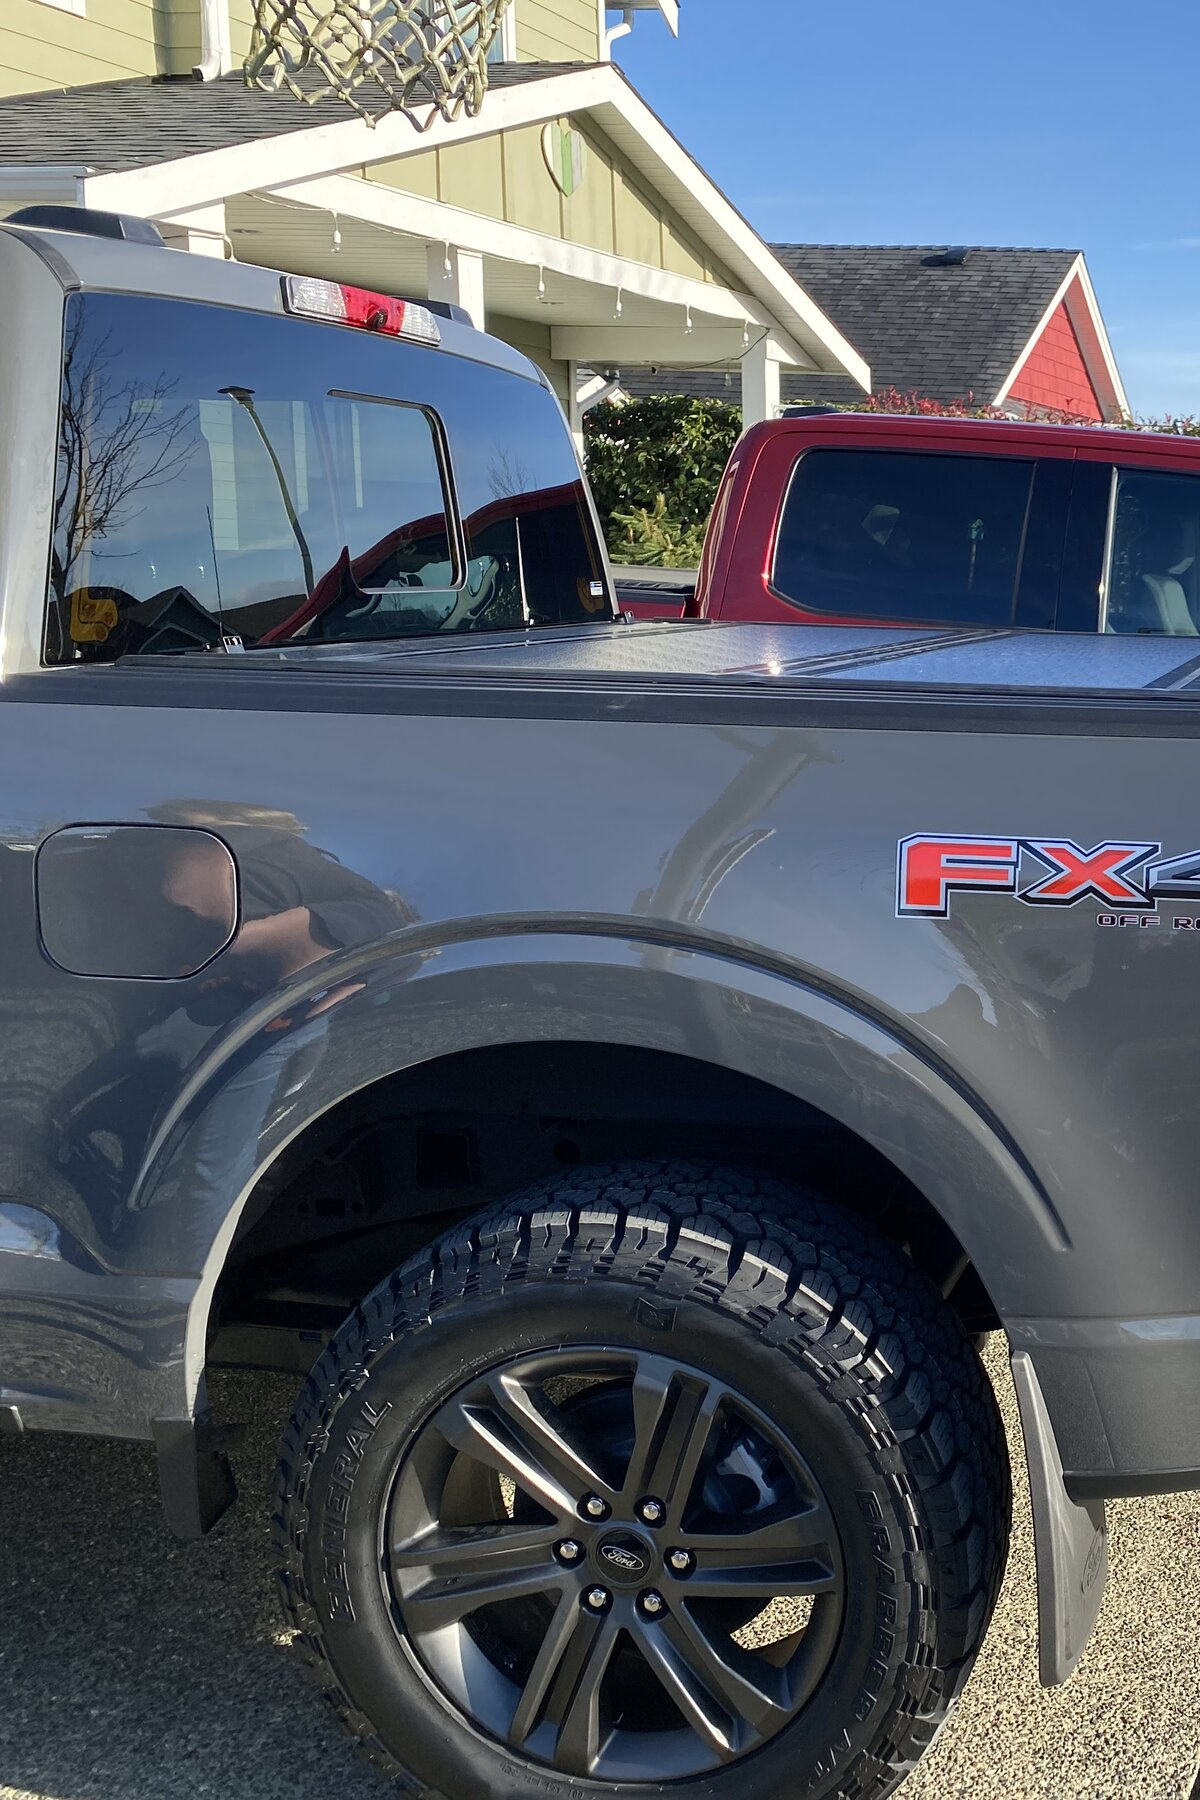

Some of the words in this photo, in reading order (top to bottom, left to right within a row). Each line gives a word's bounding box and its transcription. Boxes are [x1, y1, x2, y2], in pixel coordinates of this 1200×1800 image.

[1096, 912, 1161, 929] OFF
[320, 1401, 393, 1623] GENERAL
[607, 1549, 637, 1568] Ford
